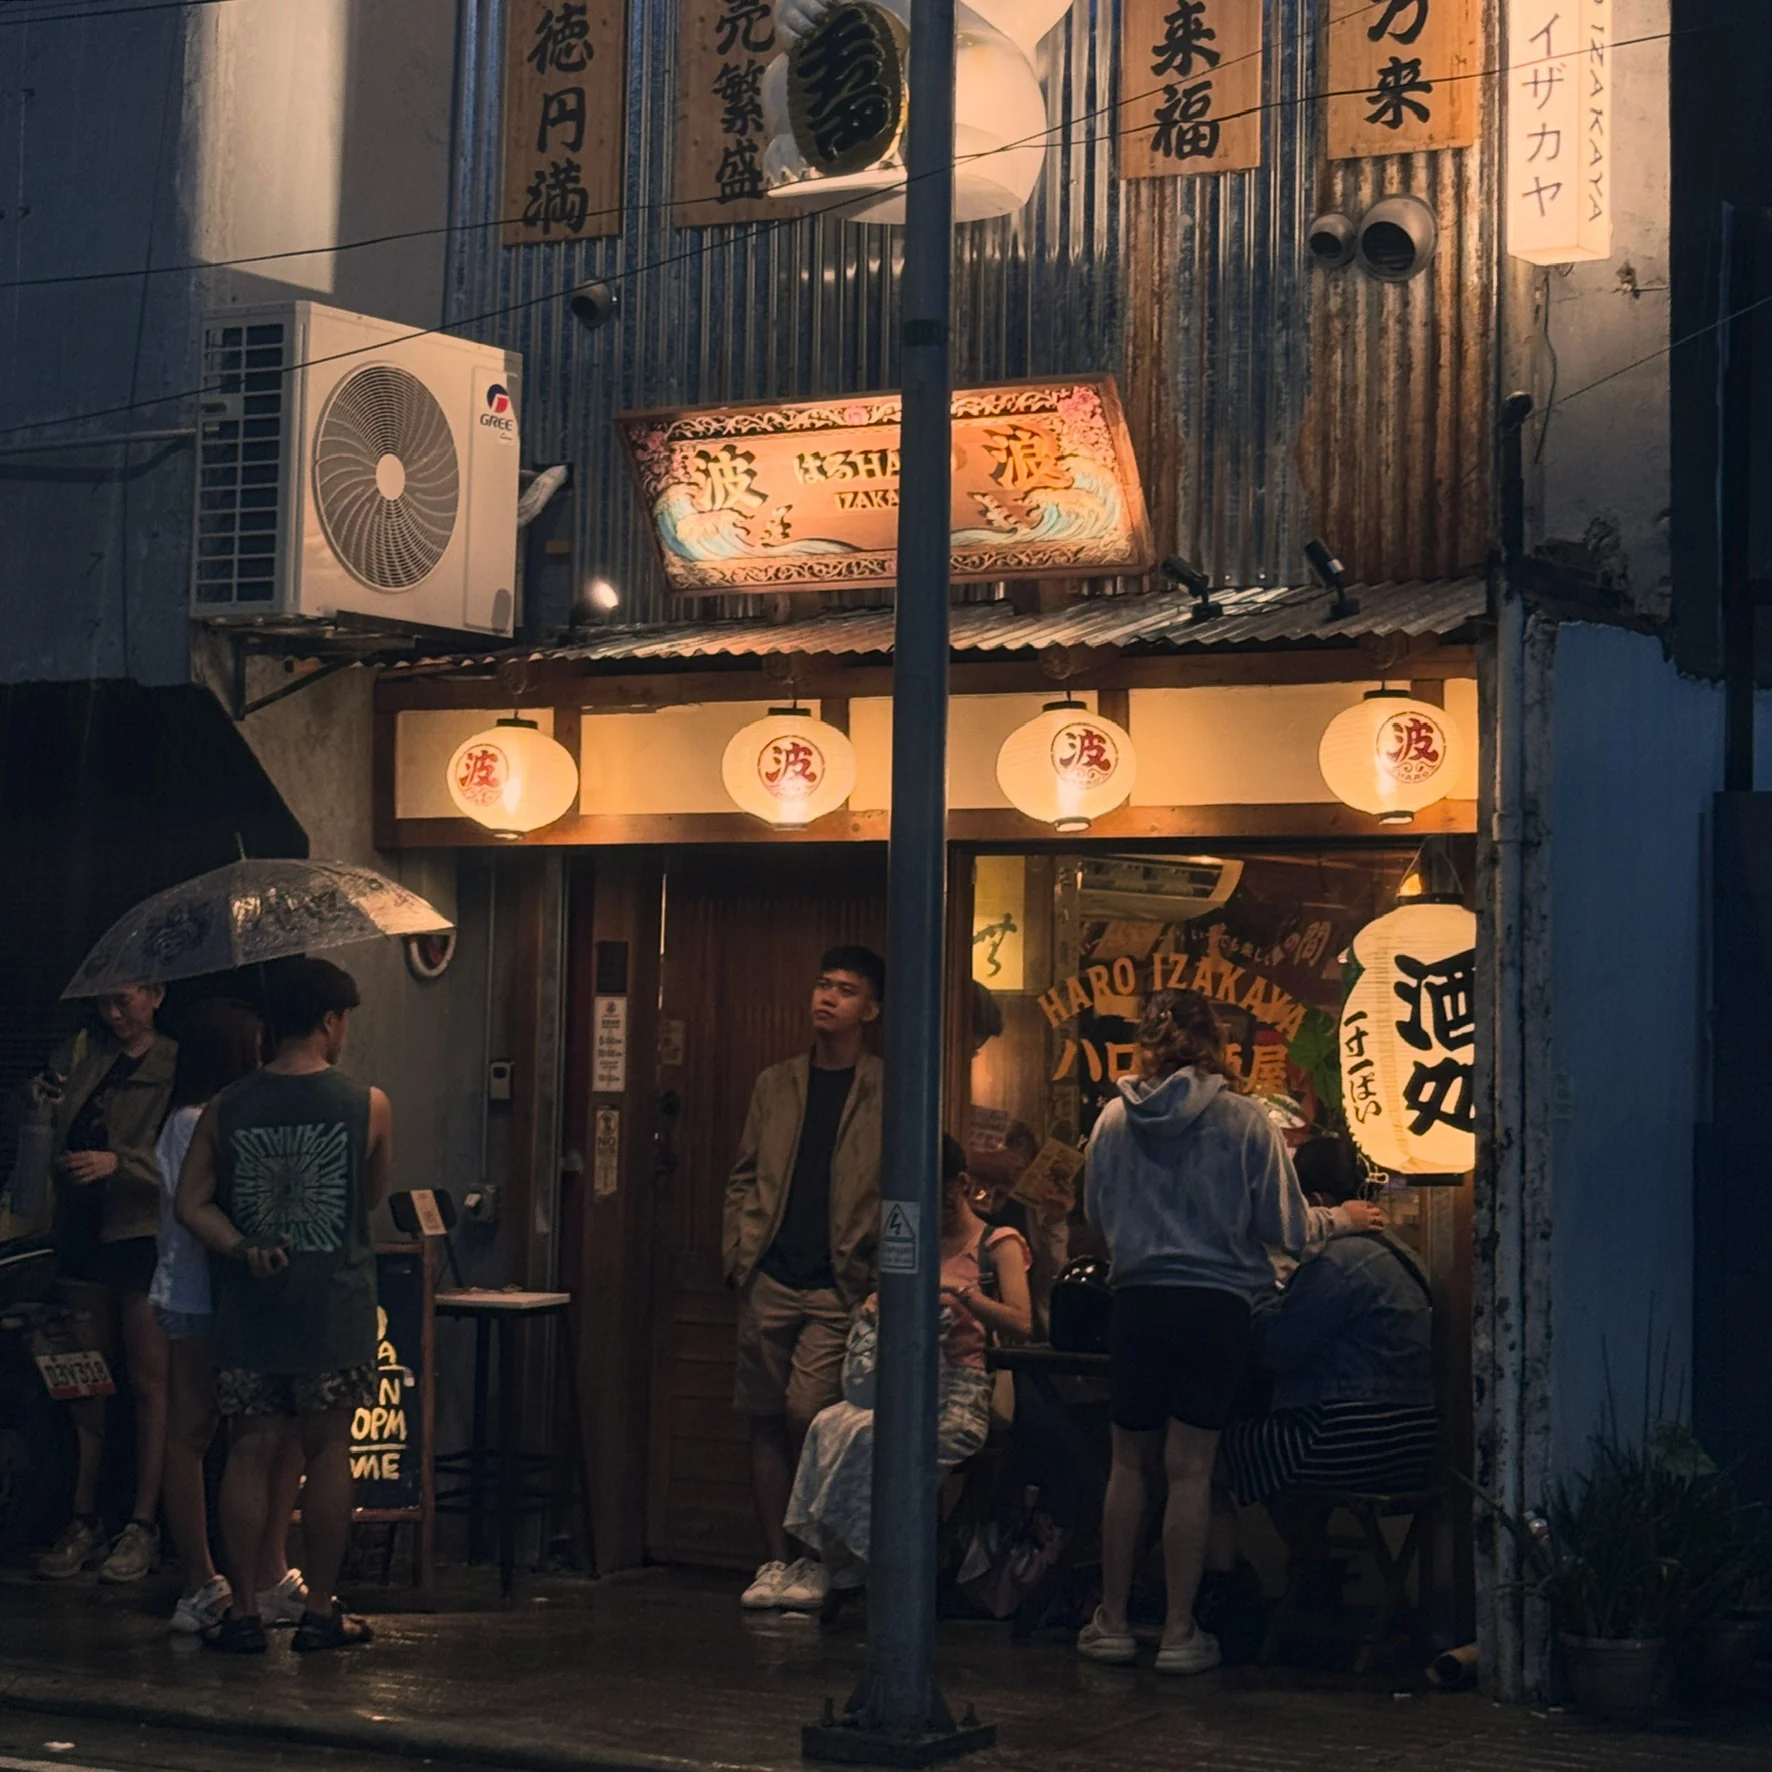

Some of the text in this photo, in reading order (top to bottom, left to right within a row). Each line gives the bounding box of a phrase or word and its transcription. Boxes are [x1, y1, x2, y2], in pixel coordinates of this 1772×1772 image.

[1150, 0, 1221, 160] 来福
[522, 3, 594, 236] 徳円満
[1521, 12, 1566, 218] イザカヤ
[1588, 23, 1605, 223] IZAKAYA
[480, 413, 514, 431] GREE
[693, 444, 769, 511] 波
[834, 489, 899, 511] IZAKA
[764, 741, 817, 783] 波
[1059, 728, 1111, 771] 波
[1386, 717, 1439, 762] 波
[459, 749, 500, 787] 波
[1038, 952, 1309, 1042] HARO IZAKAYA
